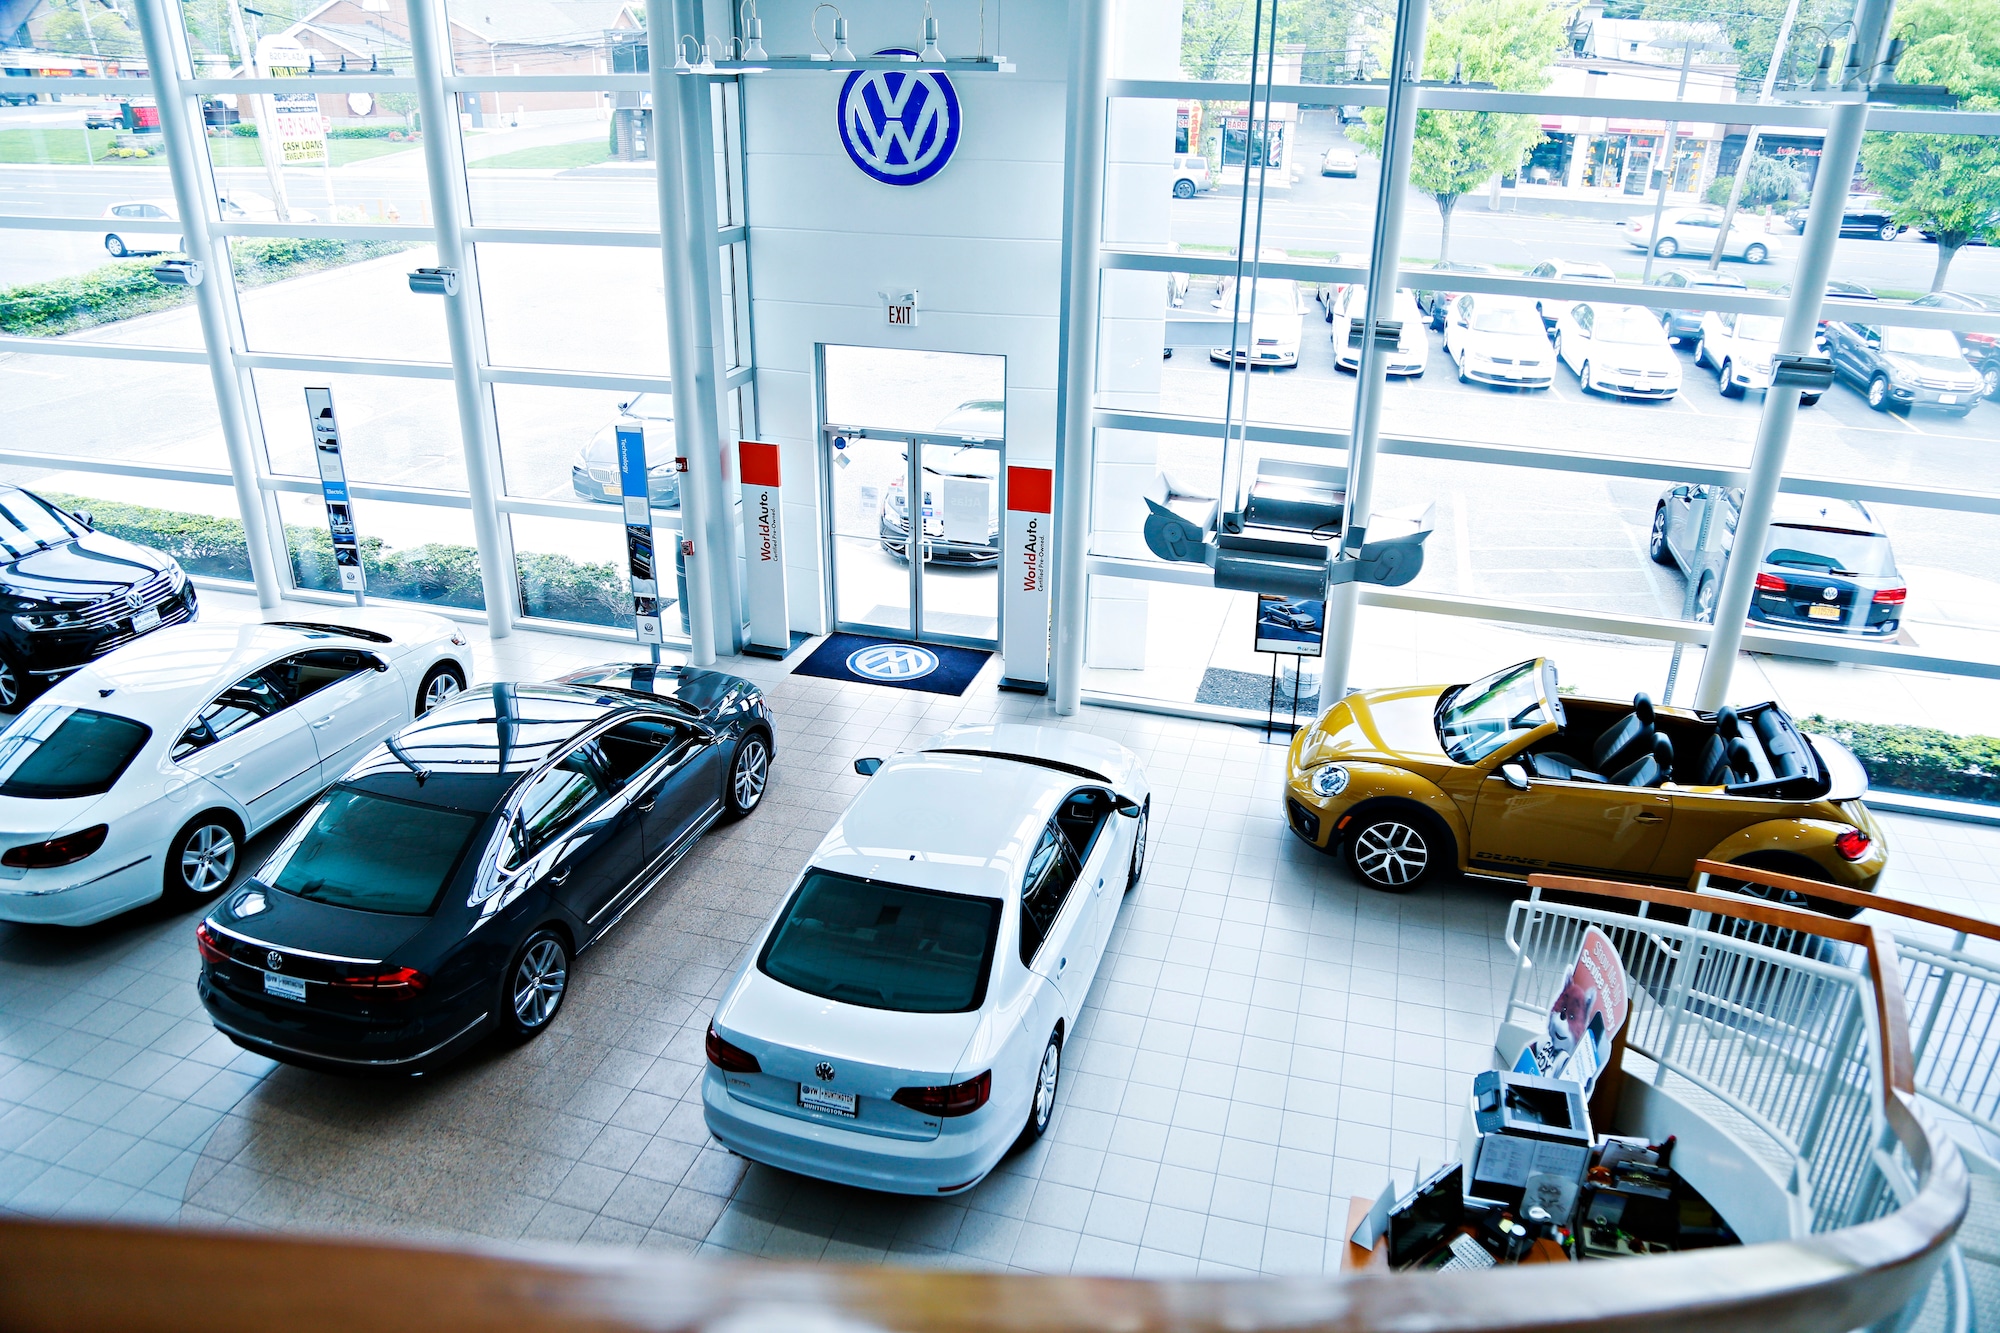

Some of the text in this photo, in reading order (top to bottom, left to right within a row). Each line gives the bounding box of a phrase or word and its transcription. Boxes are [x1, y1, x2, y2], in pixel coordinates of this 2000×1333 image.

[282, 52, 305, 61] PLAZA
[278, 117, 298, 136] RUBY
[298, 117, 322, 136] SALON
[1227, 120, 1257, 129] BARBR
[282, 140, 323, 151] CASH LOANS
[284, 150, 326, 161] JEWELRY BUYERS
[888, 305, 912, 325] EXIT
[620, 438, 629, 474] Technology
[758, 491, 771, 562] WorldAuto.
[1023, 518, 1038, 592] WorldAuto.
[1475, 851, 1545, 867] DUNE
[1593, 941, 1623, 1007] Show Me My
[1581, 949, 1616, 1032] Service History
[803, 1102, 856, 1119] HUNTINGTON.com
